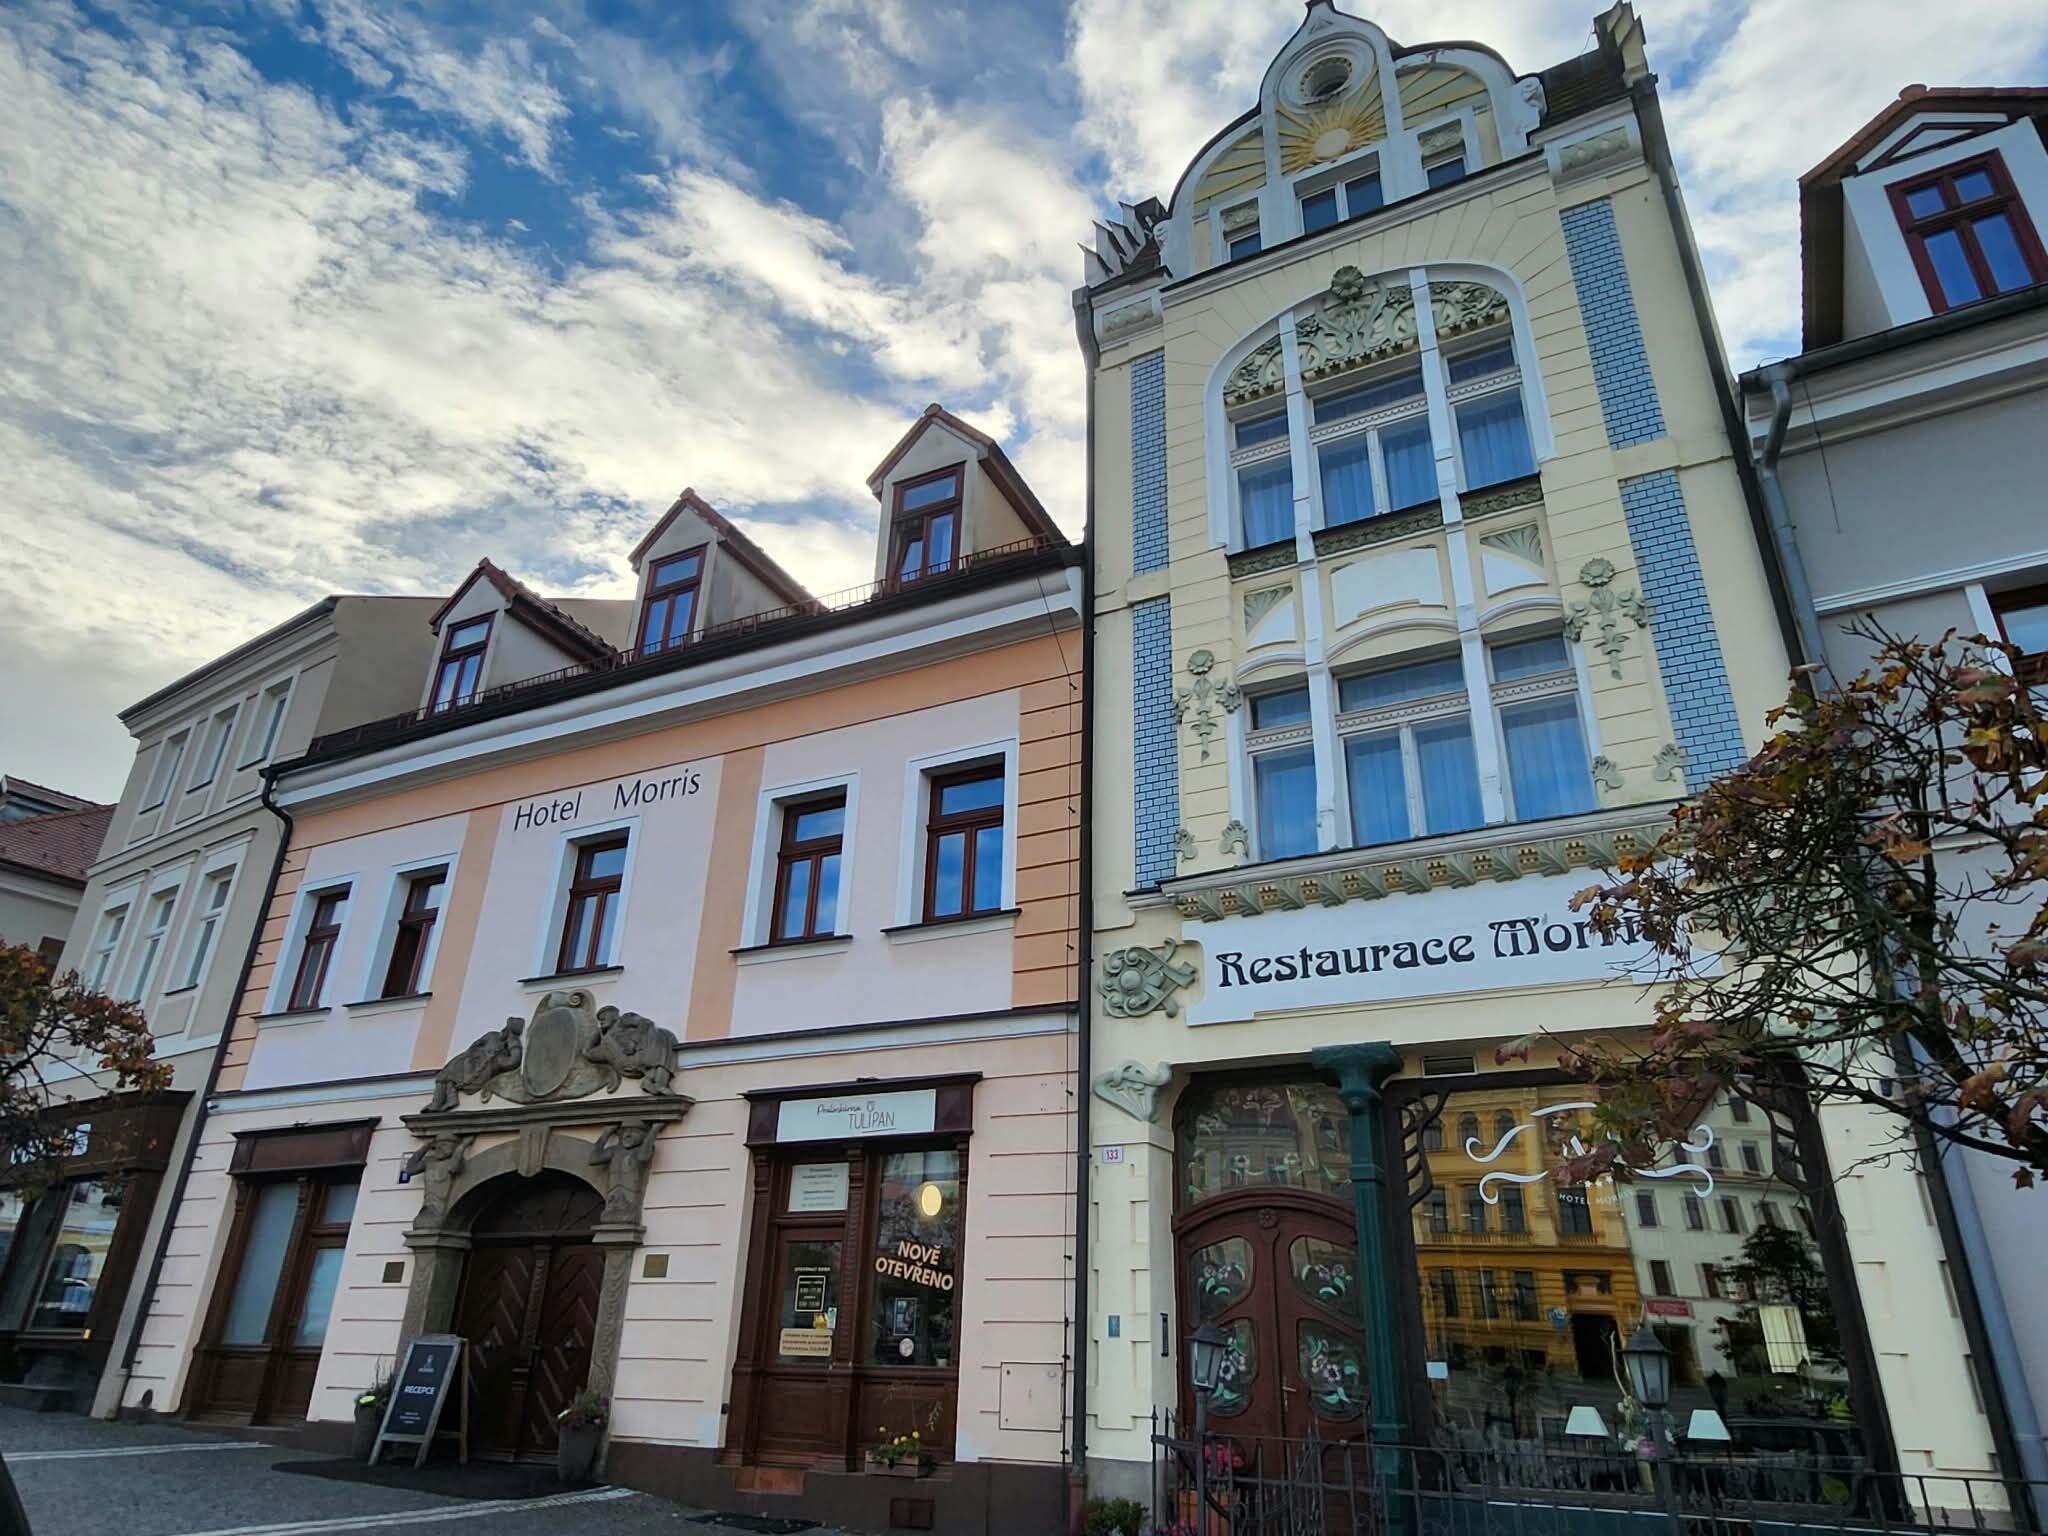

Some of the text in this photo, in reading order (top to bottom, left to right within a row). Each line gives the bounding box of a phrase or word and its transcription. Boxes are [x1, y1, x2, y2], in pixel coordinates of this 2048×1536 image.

[513, 768, 701, 832] Hotel Morris
[1215, 913, 1668, 988] Restaurace Morri
[875, 1257, 954, 1291] OTEVŘENO
[898, 1240, 942, 1265] NOVĚ
